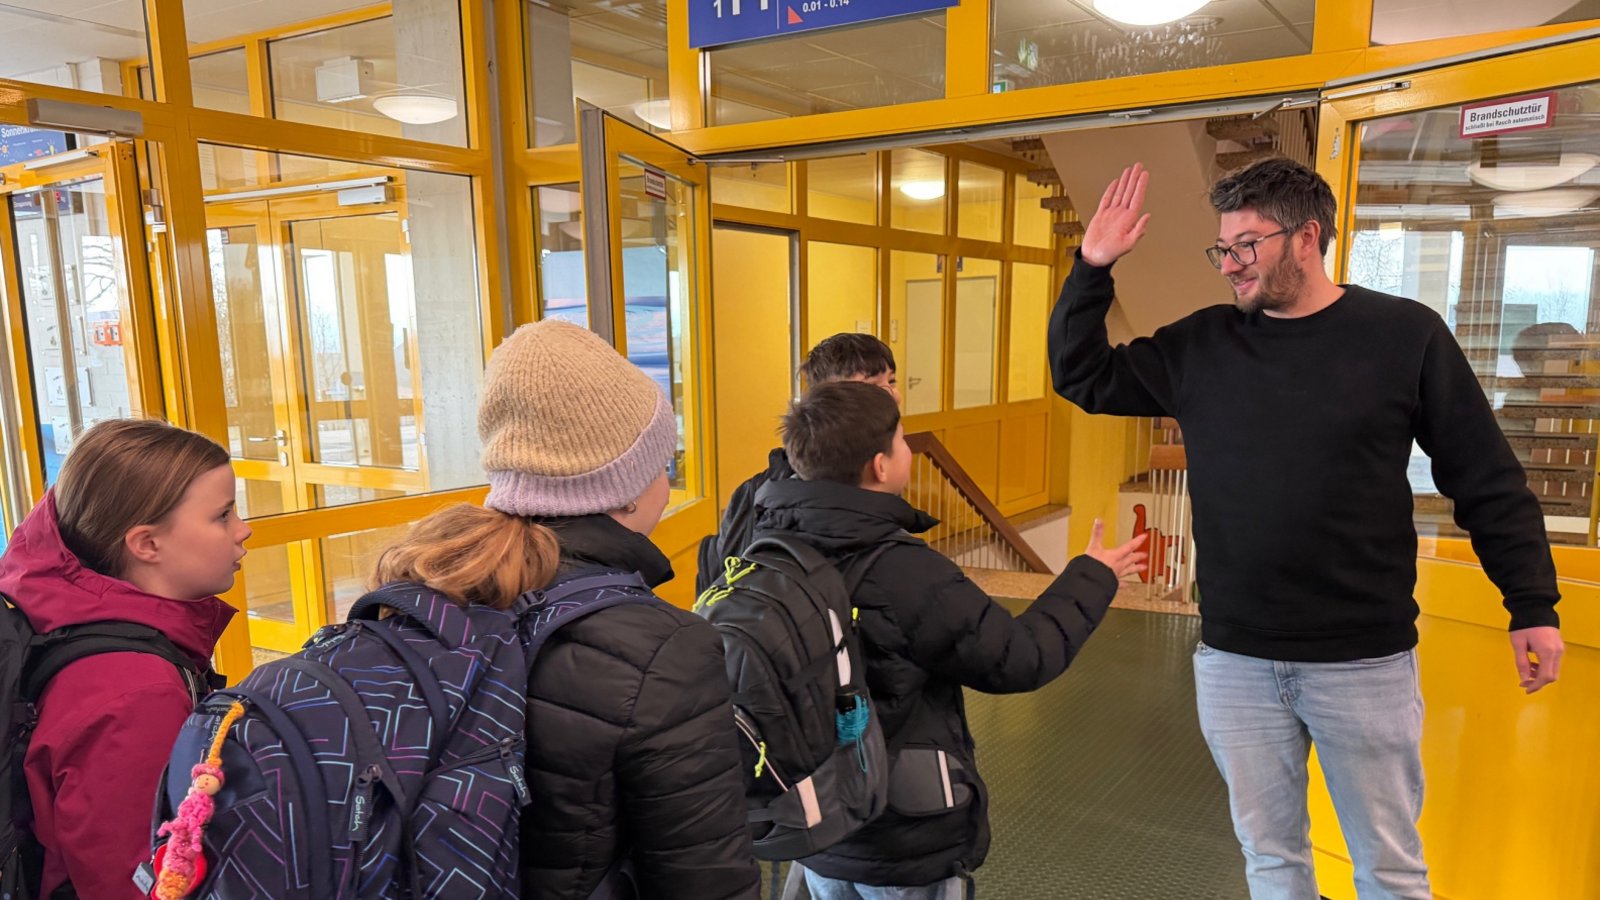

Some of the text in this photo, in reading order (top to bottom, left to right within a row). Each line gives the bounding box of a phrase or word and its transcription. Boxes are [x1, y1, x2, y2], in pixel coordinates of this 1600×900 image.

[802, 0, 821, 13] 0.01
[1465, 122, 1485, 131] schließt
[1512, 114, 1545, 124] automatisch
[1470, 103, 1542, 122] Brandschutztür
[207, 715, 221, 741] atch
[509, 765, 527, 798] Satch
[352, 795, 365, 832] Satch
